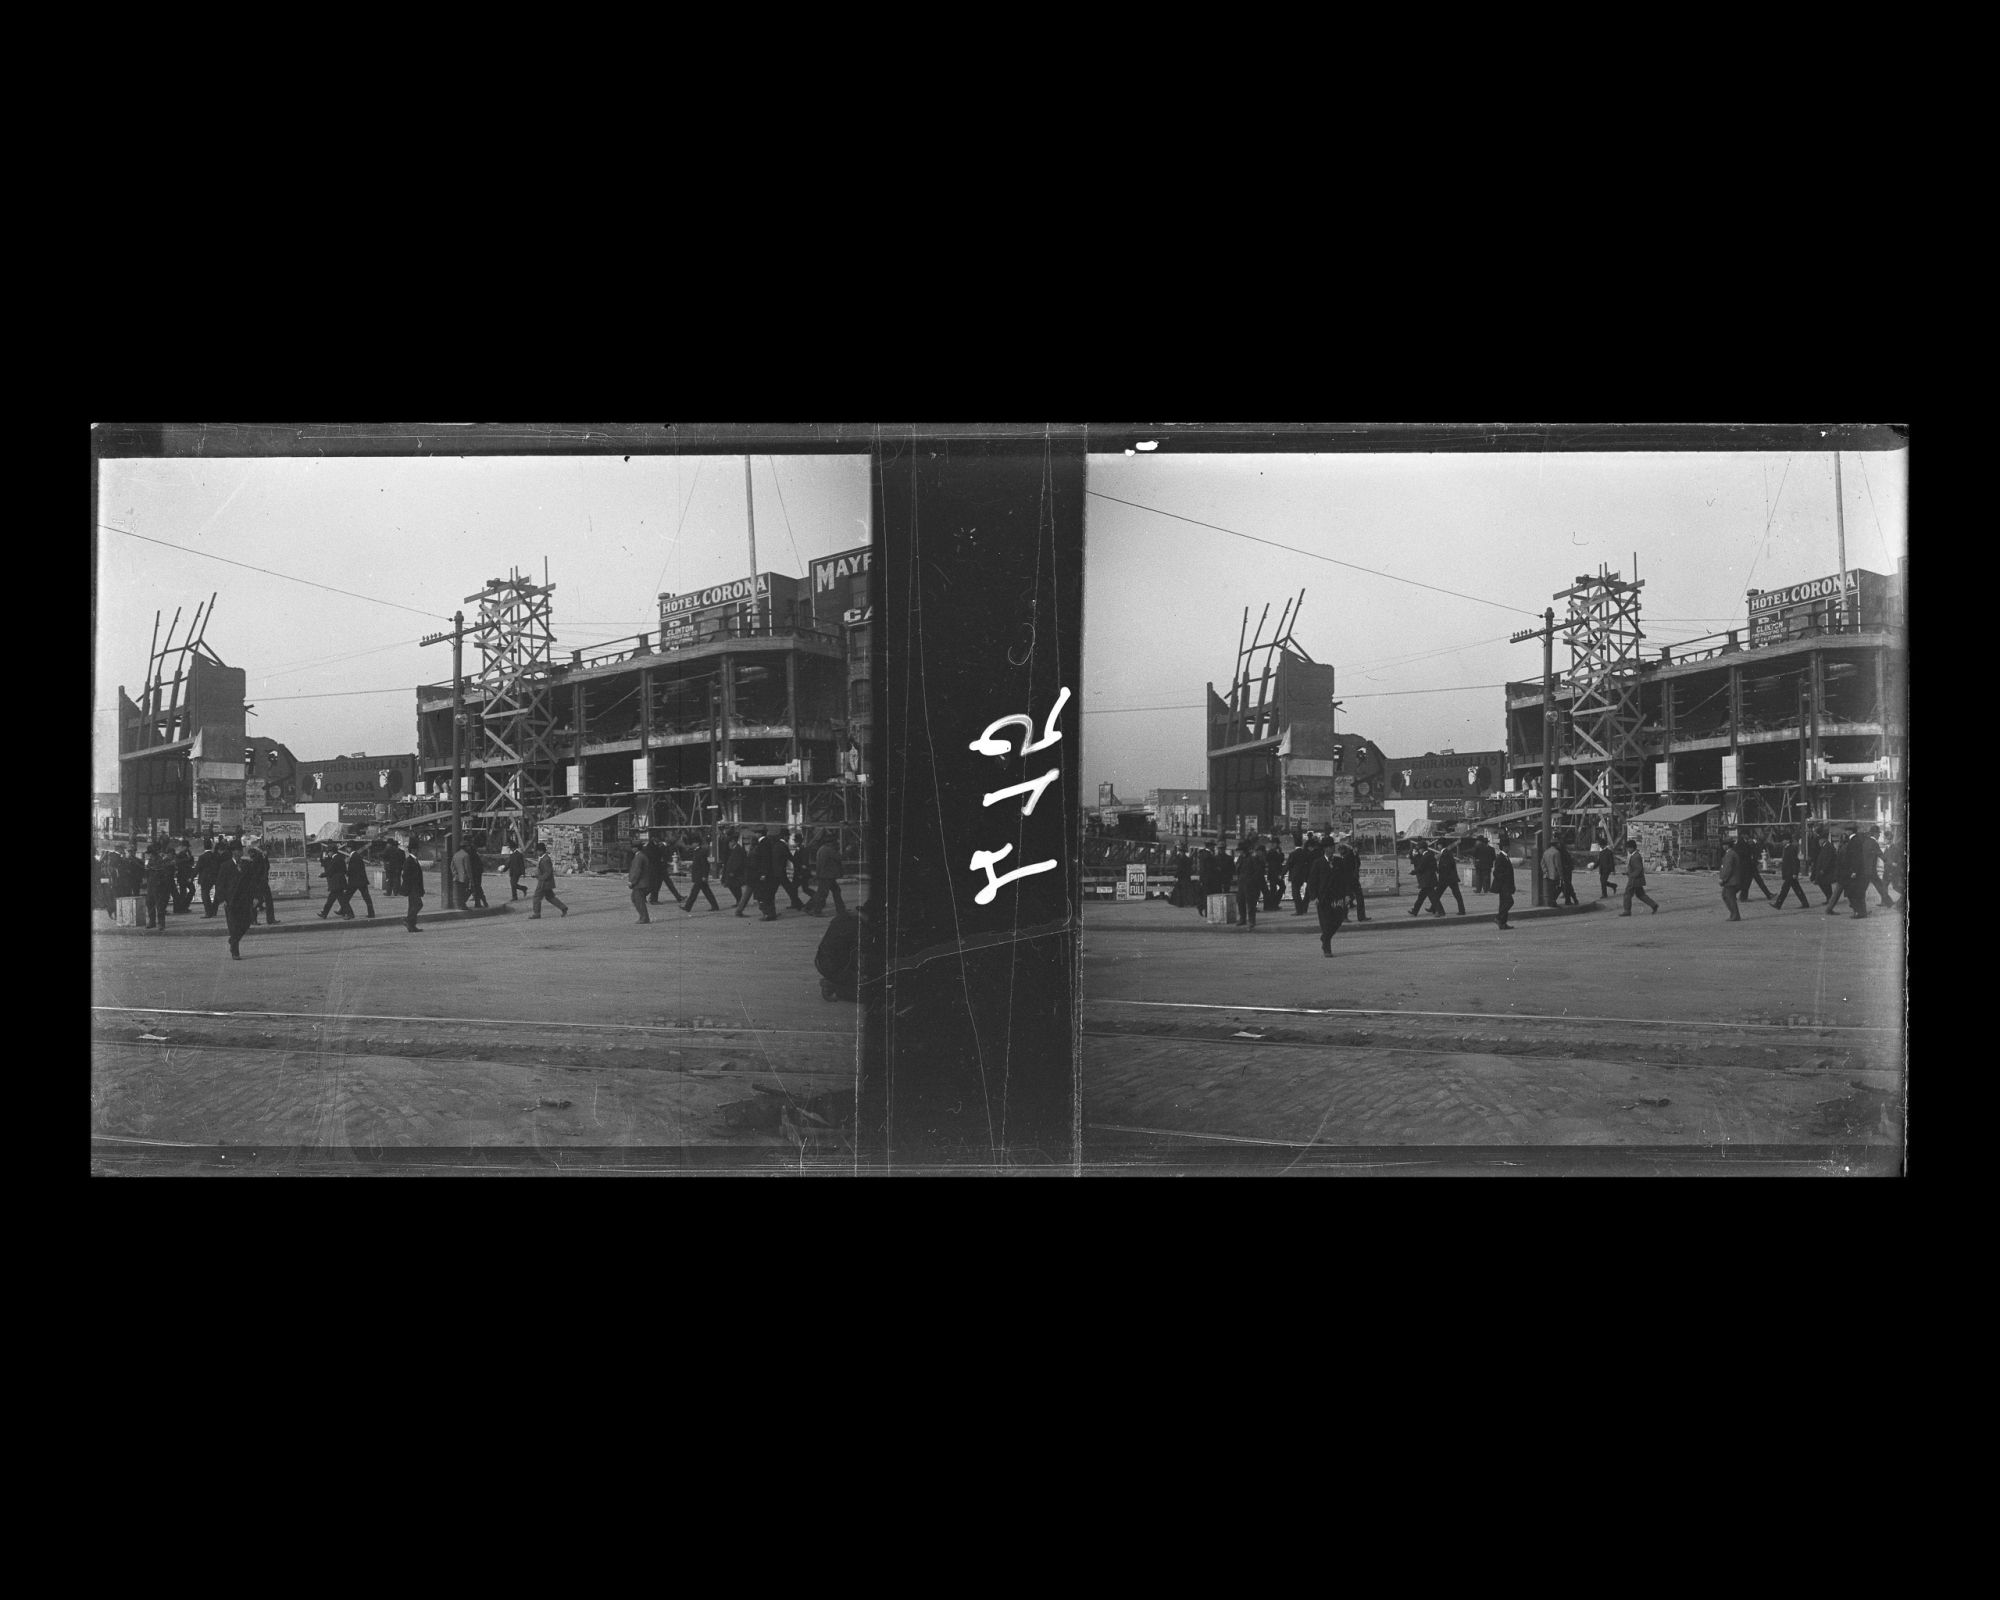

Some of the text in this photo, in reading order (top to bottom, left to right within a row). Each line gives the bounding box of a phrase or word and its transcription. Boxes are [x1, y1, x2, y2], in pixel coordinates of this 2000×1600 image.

[662, 576, 767, 614] HOTEL CORONA
[1751, 573, 1857, 610] HOTEL CORONA
[666, 624, 694, 637] CLINTON
[1756, 621, 1784, 633] CLINTON
[324, 781, 375, 793] COCOA
[1413, 778, 1464, 790] COCOA
[1130, 873, 1144, 883] PAID
[1130, 885, 1144, 895] FULL
